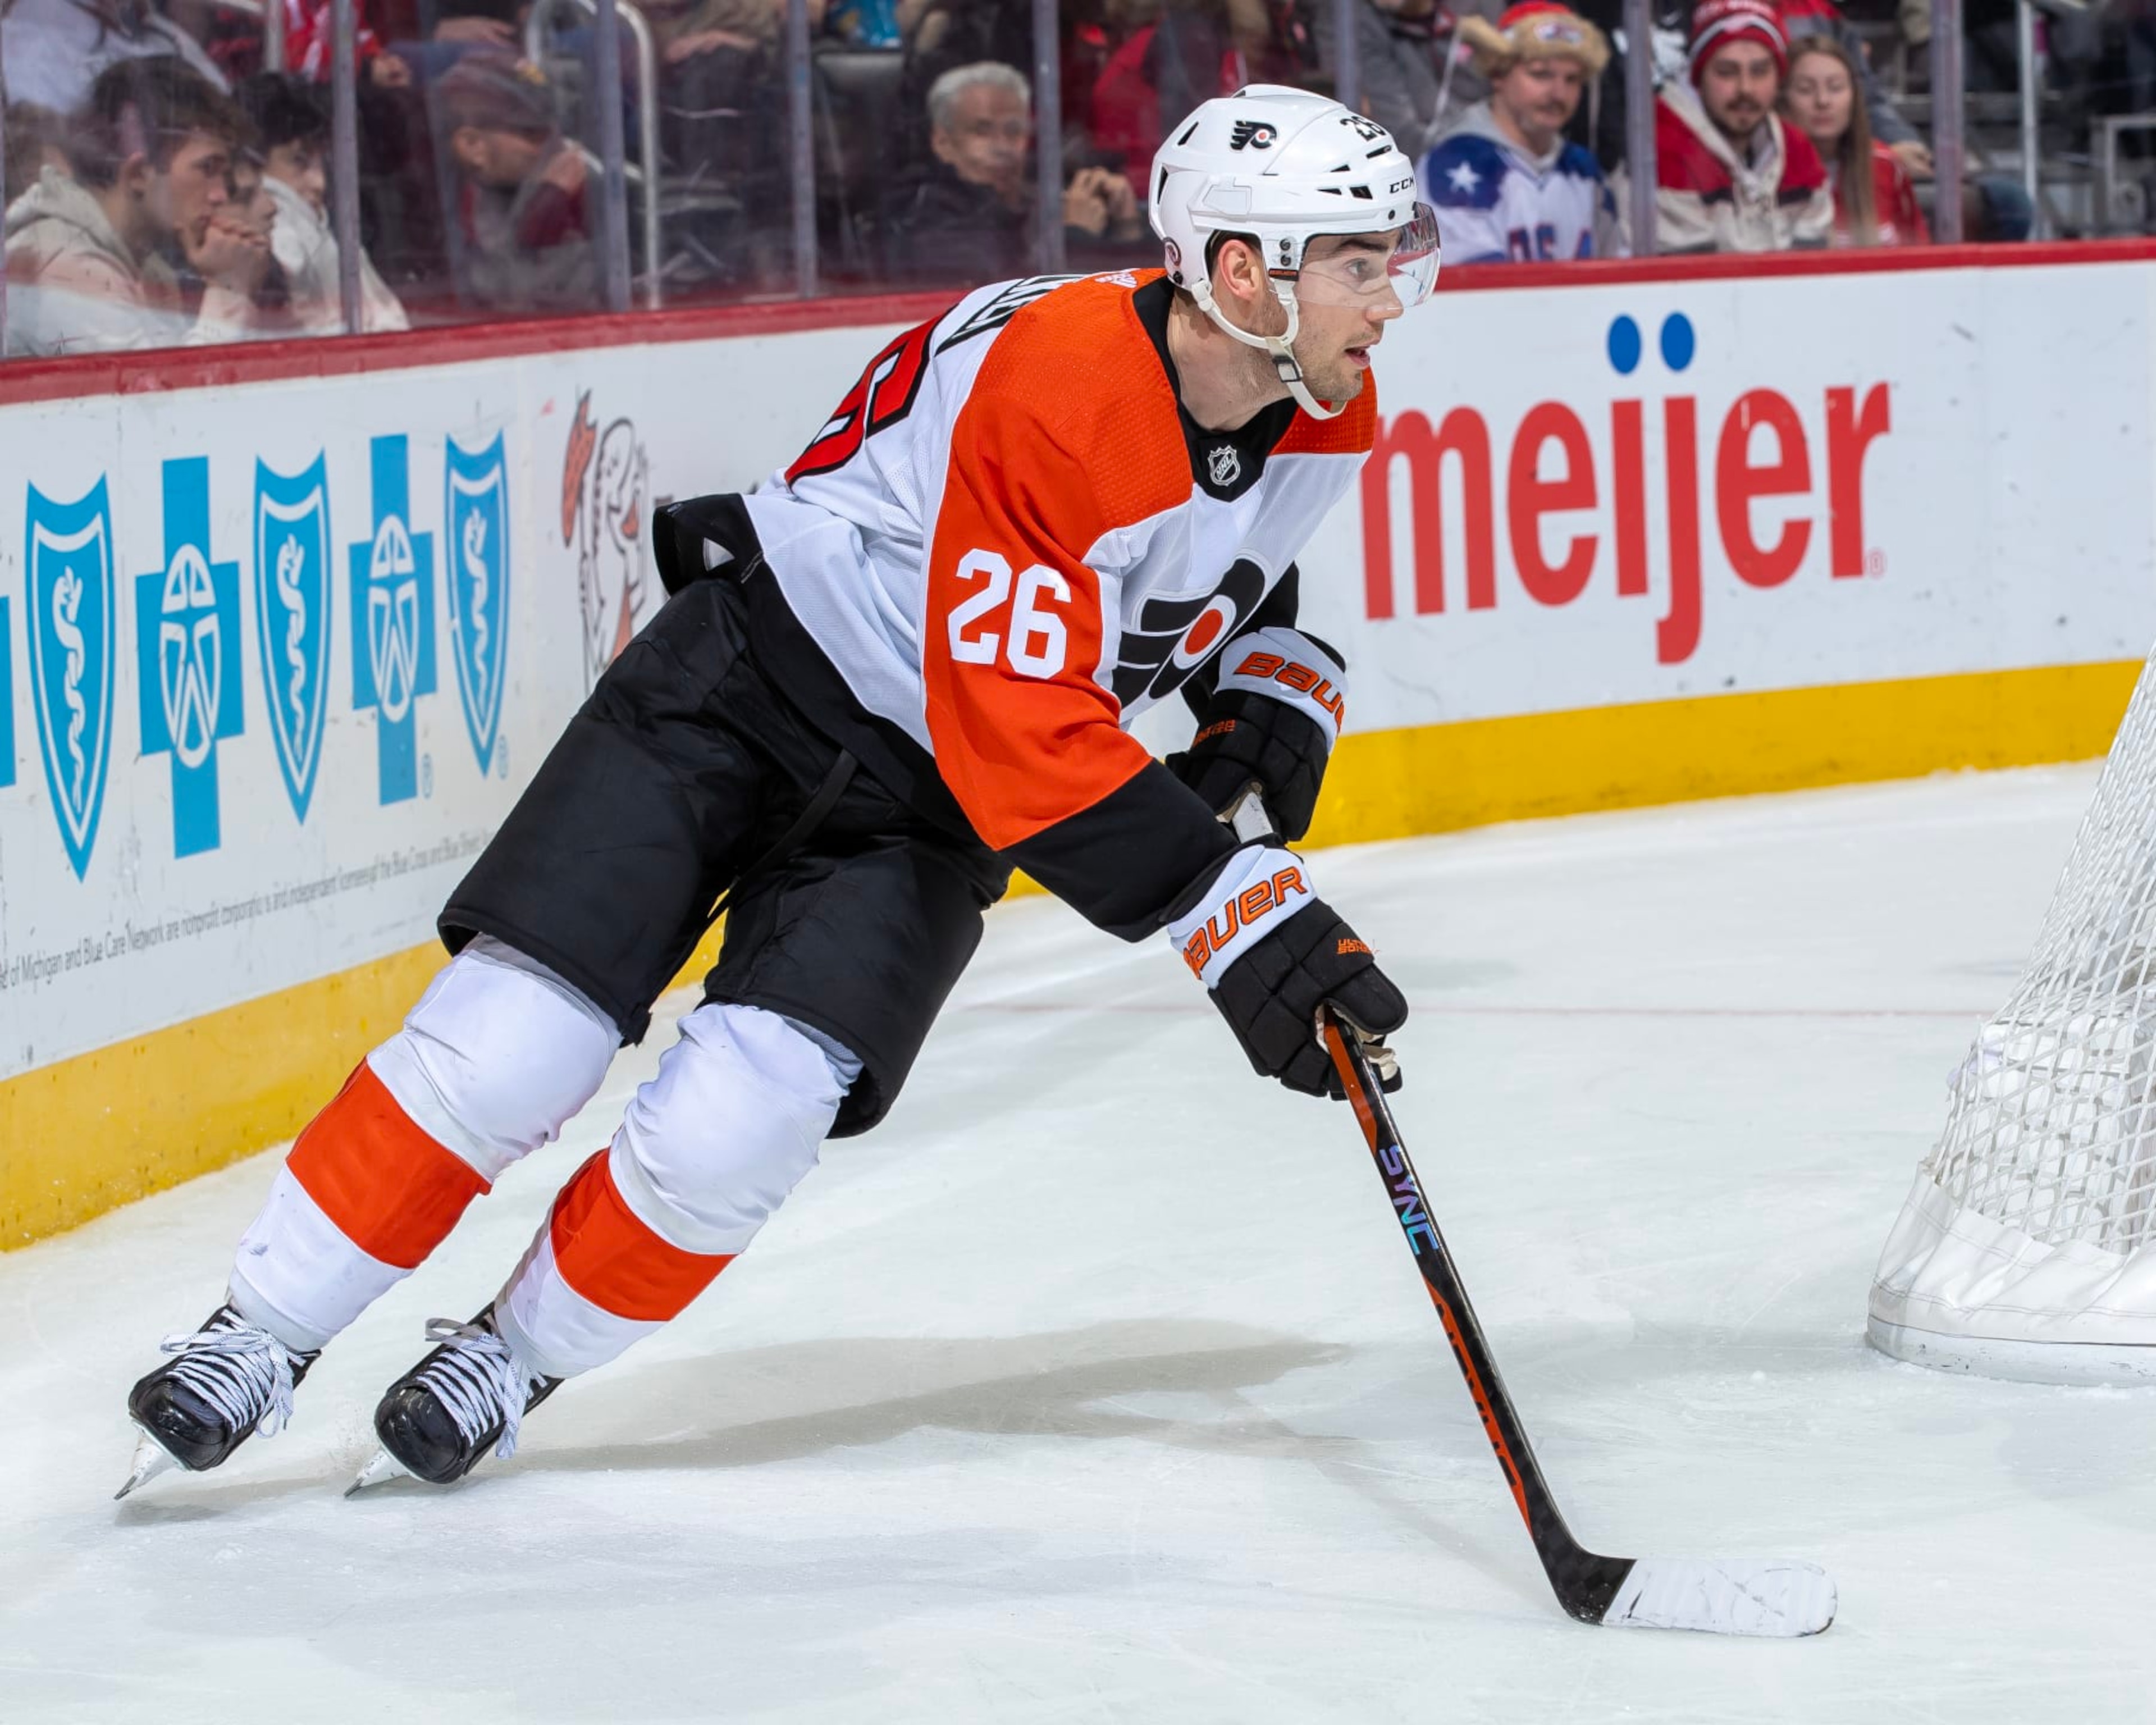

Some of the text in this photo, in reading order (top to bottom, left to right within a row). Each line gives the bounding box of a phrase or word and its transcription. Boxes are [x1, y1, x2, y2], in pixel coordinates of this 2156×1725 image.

[1360, 311, 1891, 665] meijer
[948, 547, 1072, 680] 26
[1232, 651, 1345, 734] BAU
[65, 939, 82, 970] and
[104, 930, 126, 958] Care
[1183, 865, 1308, 980] AUER
[1379, 1144, 1440, 1256] SYNC
